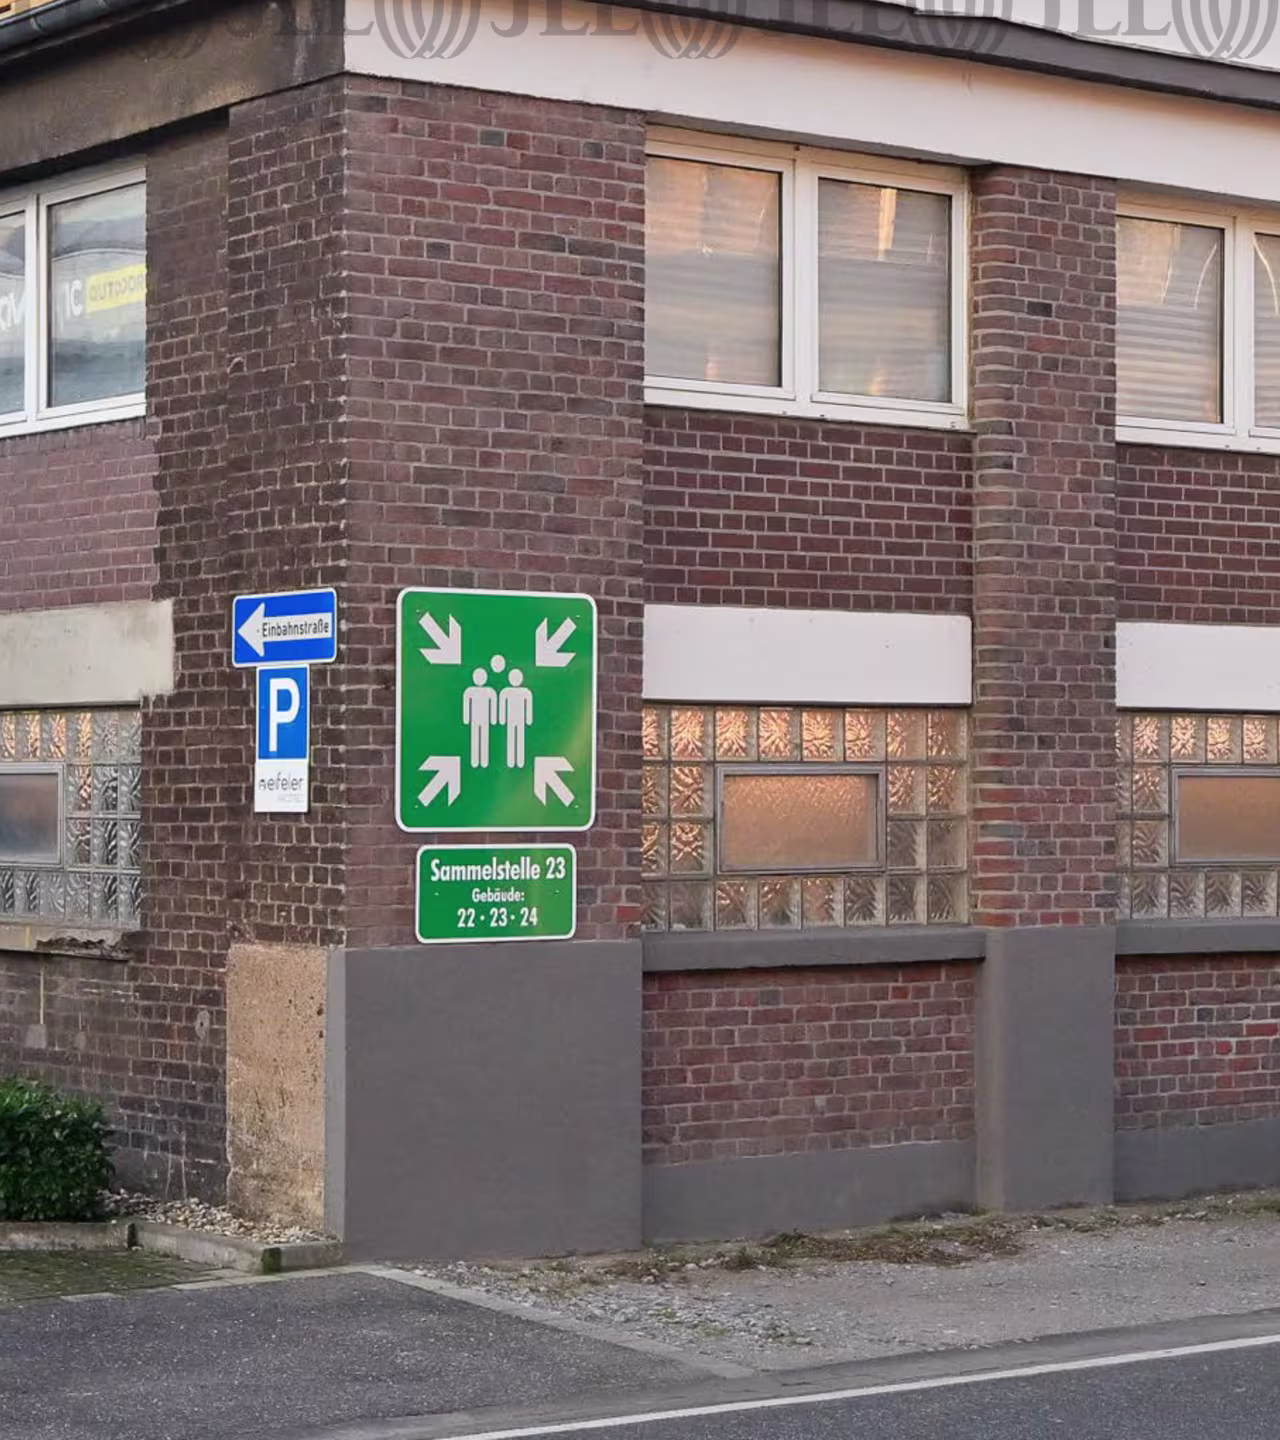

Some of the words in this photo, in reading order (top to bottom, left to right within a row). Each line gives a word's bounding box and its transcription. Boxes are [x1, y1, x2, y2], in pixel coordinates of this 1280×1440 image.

[261, 618, 329, 638] Einbahnstraße
[269, 677, 301, 752] P
[430, 856, 541, 882] Sammelstelle
[545, 856, 566, 880] 23
[471, 887, 525, 903] Gebäude:
[457, 908, 476, 928] 22
[489, 908, 508, 927] 23
[520, 906, 538, 926] 24
